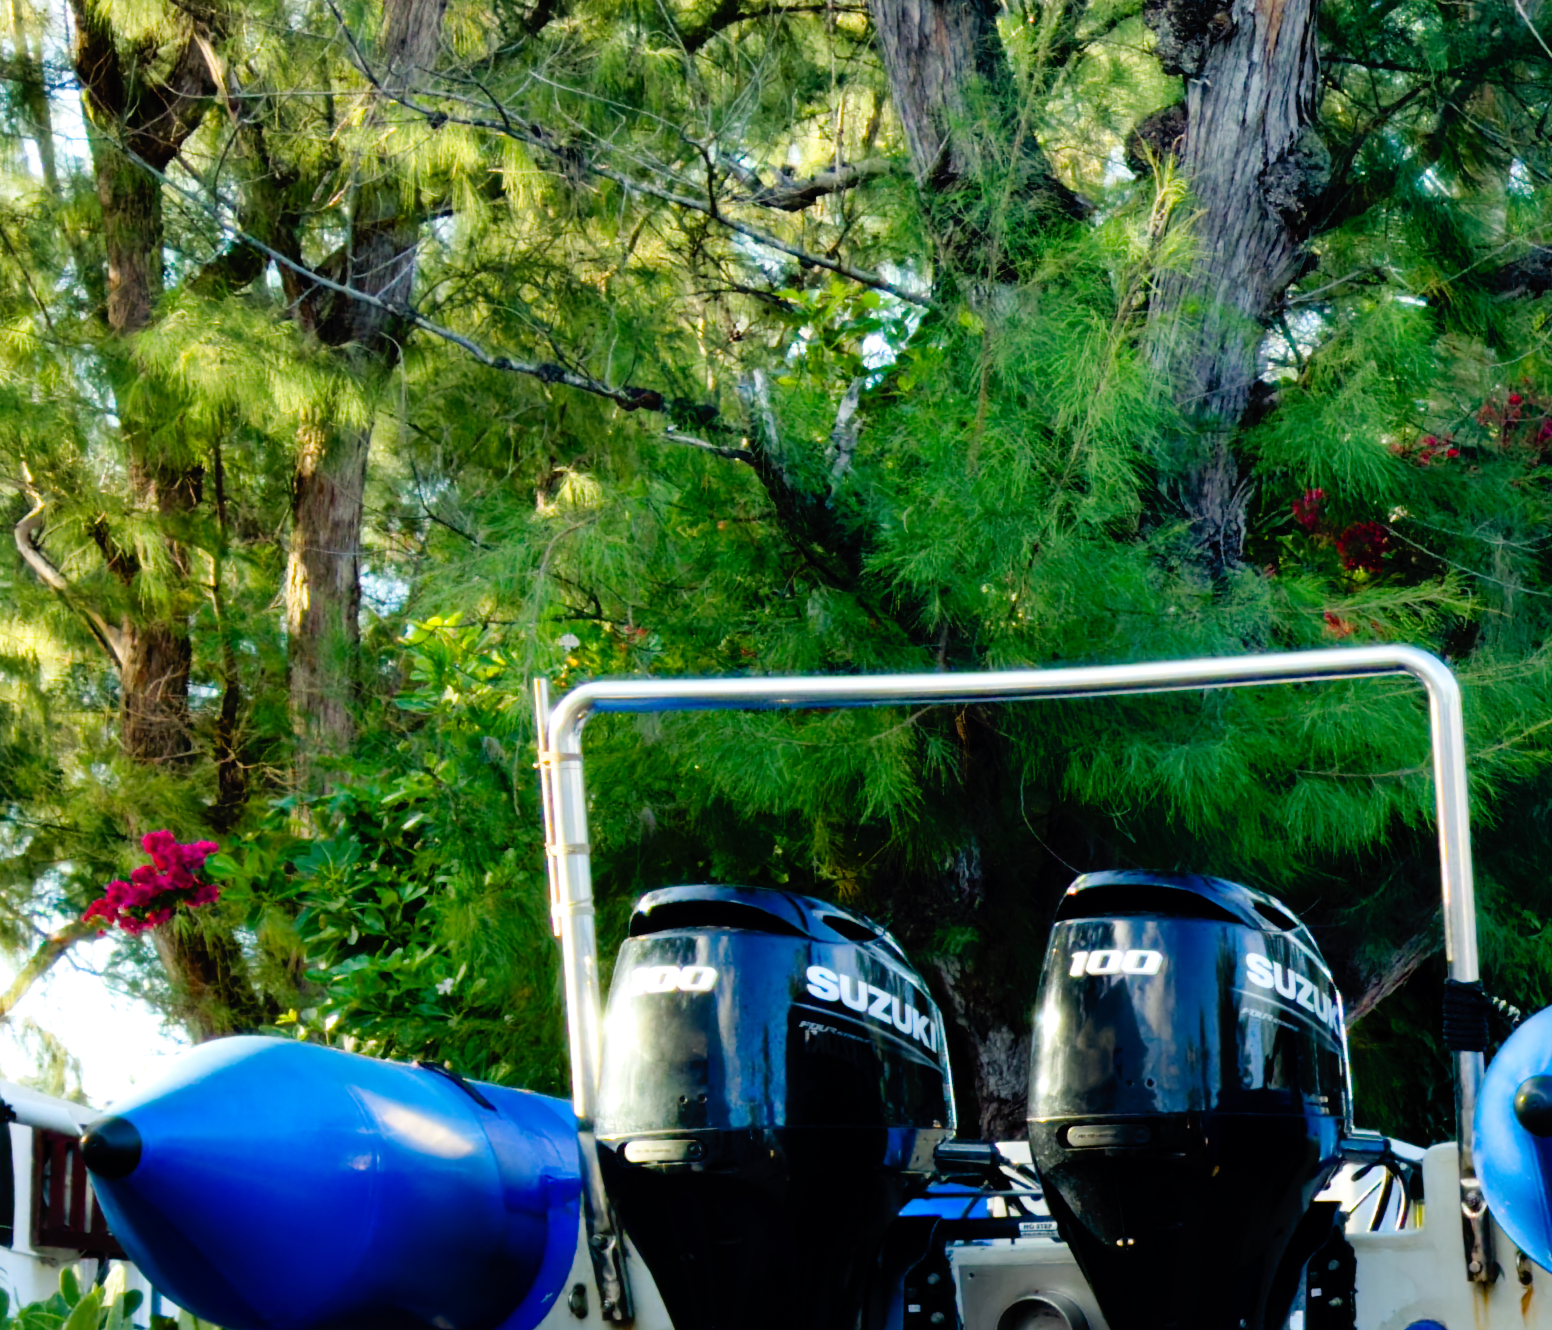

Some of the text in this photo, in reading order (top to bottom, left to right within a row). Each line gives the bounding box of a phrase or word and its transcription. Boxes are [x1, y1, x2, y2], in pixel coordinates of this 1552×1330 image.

[1069, 949, 1164, 978] 100
[1245, 952, 1340, 1037] SUZUK
[806, 965, 938, 1054] SUZUKI
